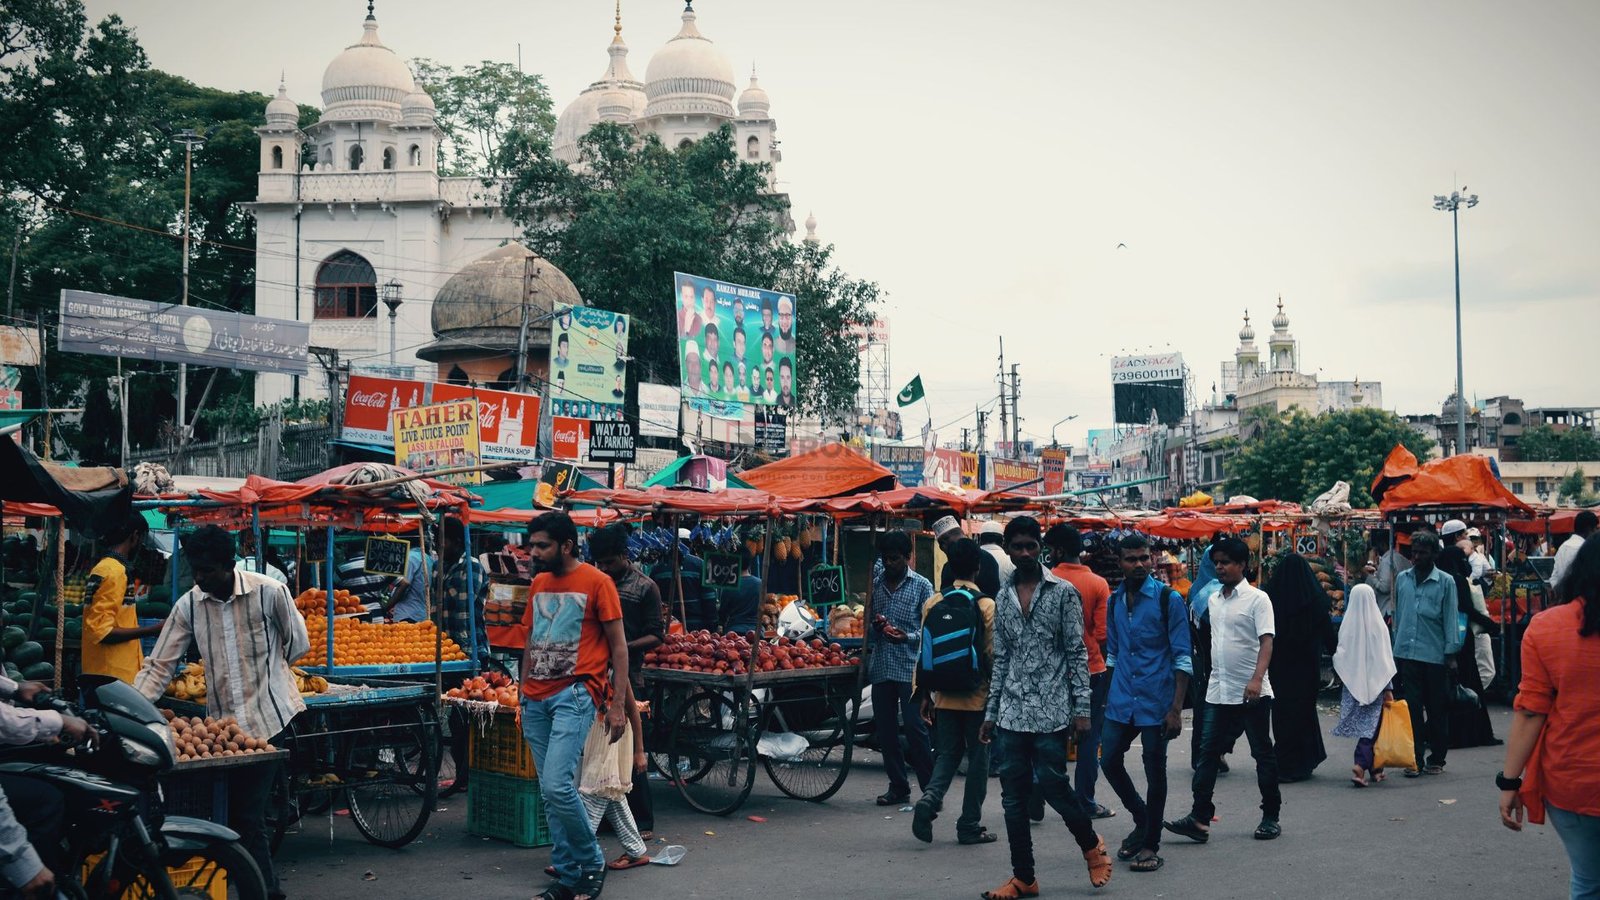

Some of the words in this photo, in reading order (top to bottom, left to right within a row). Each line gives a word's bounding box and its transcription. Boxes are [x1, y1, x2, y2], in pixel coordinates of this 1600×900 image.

[89, 305, 117, 318] NIZAMIA
[118, 308, 148, 321] GENERAL
[149, 312, 181, 326] HOSPITAL
[1112, 368, 1180, 381] 7396001111
[397, 403, 473, 429] TAHER
[401, 429, 418, 443] LIVE
[420, 426, 443, 440] JUICE
[446, 423, 470, 437] POINT
[595, 423, 617, 436] WAY
[617, 423, 630, 436] TO
[407, 443, 427, 453] LASSI
[429, 441, 434, 450] &
[436, 437, 464, 449] FALUDA
[485, 445, 503, 454] TAHER
[503, 447, 515, 455] PAN
[515, 448, 531, 456] SHOP
[1297, 536, 1316, 554] 60
